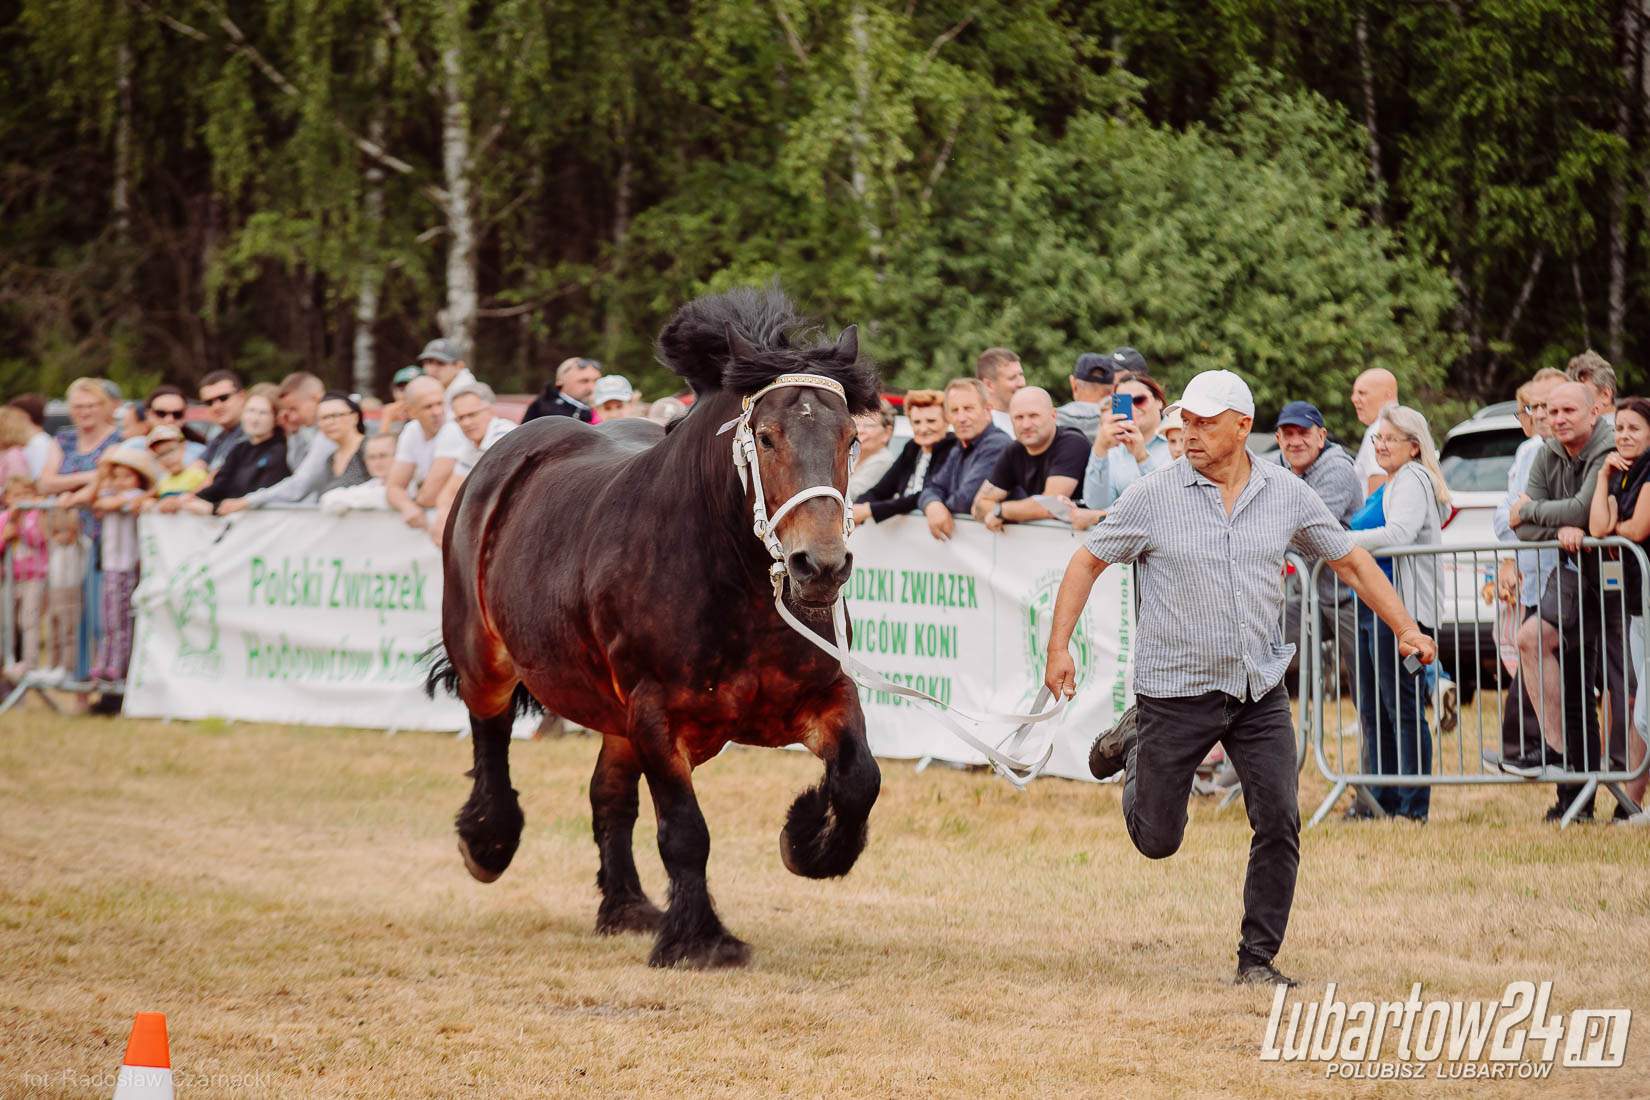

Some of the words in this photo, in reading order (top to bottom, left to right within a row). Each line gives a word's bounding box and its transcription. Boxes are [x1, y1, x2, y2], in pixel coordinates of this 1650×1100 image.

[250, 555, 323, 607] Polski
[326, 557, 427, 624] Związek
[901, 569, 978, 612] ZWIĄZEK
[914, 622, 959, 659] KONI
